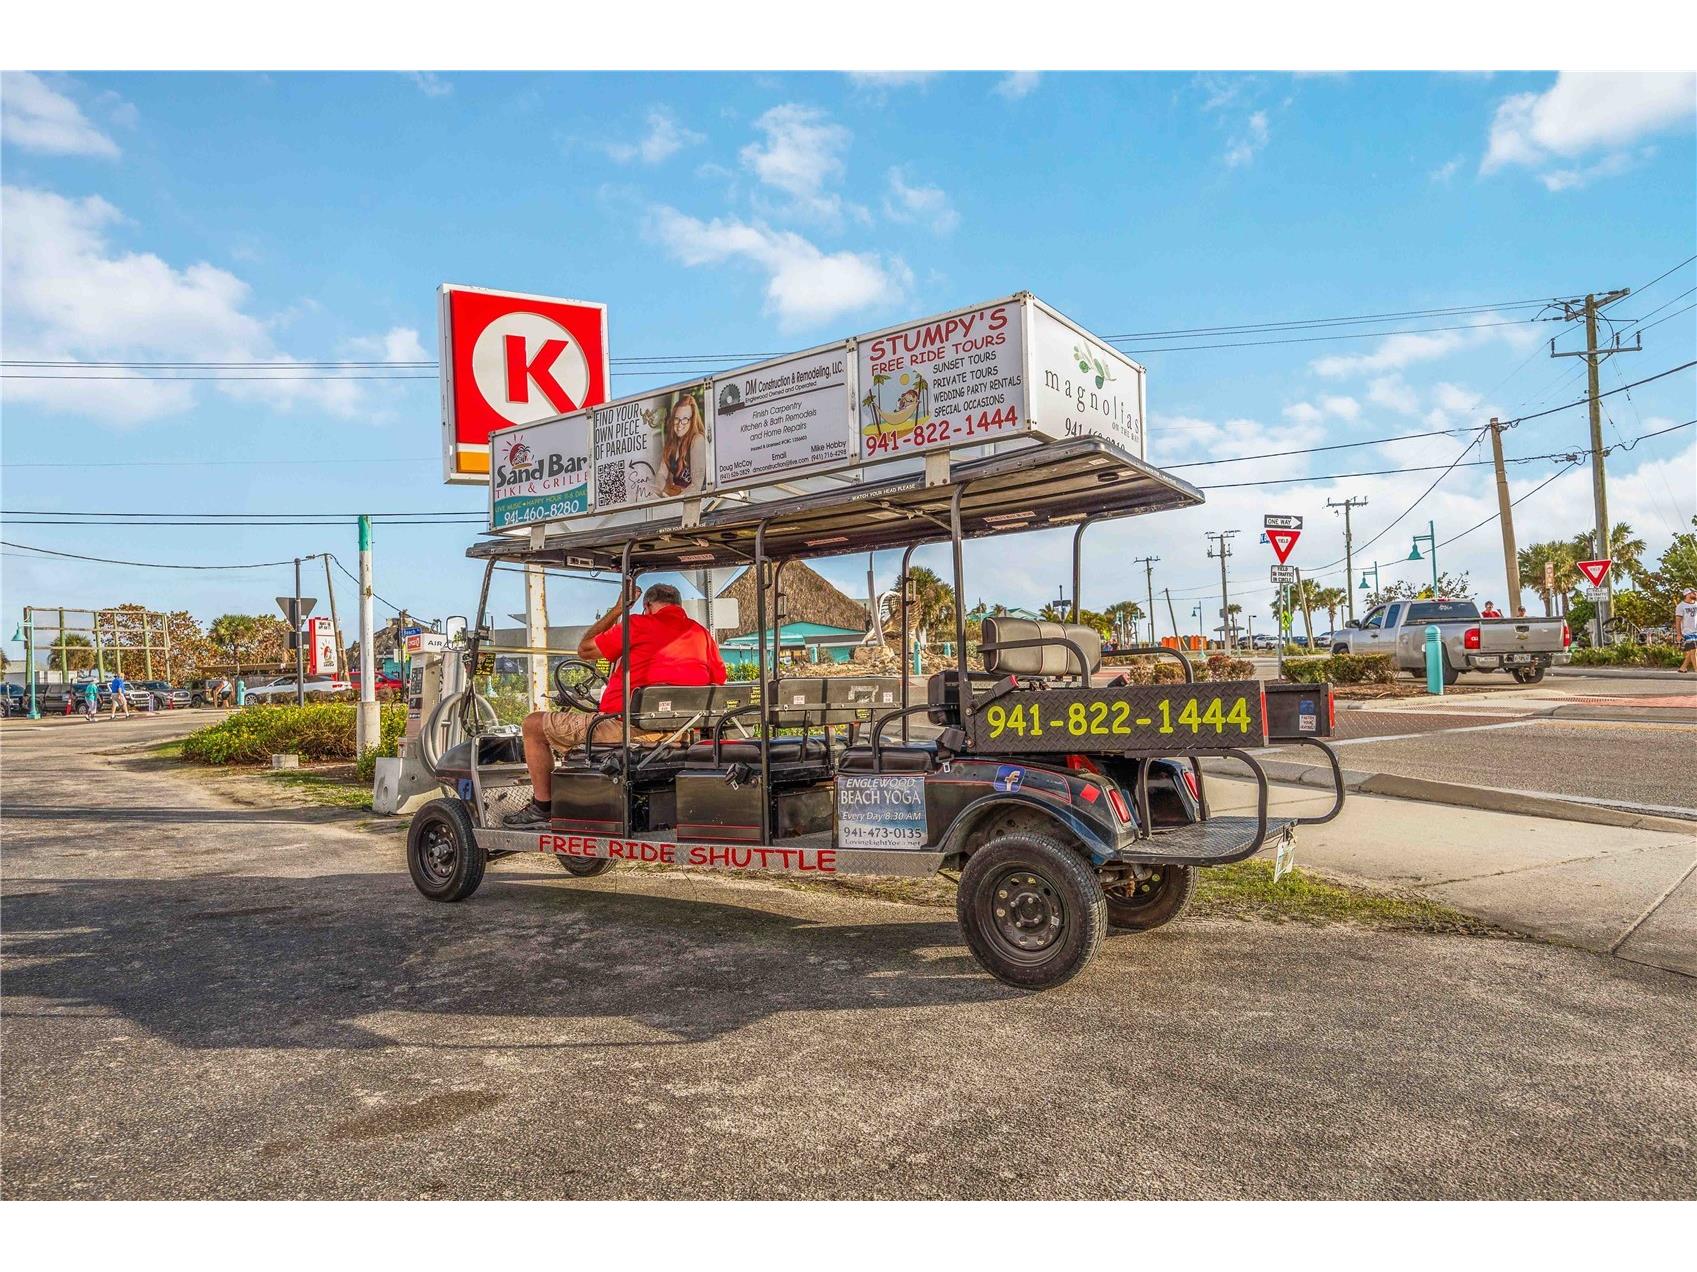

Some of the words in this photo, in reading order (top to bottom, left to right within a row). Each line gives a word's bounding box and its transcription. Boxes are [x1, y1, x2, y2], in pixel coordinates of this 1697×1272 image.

[869, 307, 1008, 361] STUMPY'S
[871, 356, 904, 376] FREE
[910, 346, 945, 366] RIDE
[952, 332, 1006, 354] TOURS
[932, 357, 965, 374] SUNSET
[968, 350, 997, 365] TOURS
[505, 334, 579, 414] K
[745, 379, 757, 396] DM
[758, 375, 791, 393] Construction
[932, 372, 966, 389] PRIVATE
[970, 365, 998, 380] TOURS
[745, 392, 768, 403] Englewood
[768, 388, 784, 398] Owned
[785, 385, 795, 394] and
[795, 381, 817, 393] Operated
[933, 388, 965, 403] WEDDING
[967, 381, 988, 395] PARTY
[989, 375, 1022, 390] RENTALS
[1045, 369, 1139, 434] magnolias
[595, 408, 613, 428] FIND
[616, 403, 640, 422] YOUR
[752, 407, 769, 419] Finish
[769, 401, 803, 416] Carpentry
[934, 403, 961, 417] SPECIAL
[963, 393, 1005, 411] OCCASIONS
[595, 425, 613, 444] OWN
[616, 418, 640, 439] PIECE
[740, 421, 763, 433] Kitchen
[763, 419, 769, 427] &
[769, 416, 784, 426] Bath
[785, 408, 817, 421] Remodels
[750, 432, 763, 441] and
[763, 428, 782, 438] Home
[783, 422, 807, 435] Repairs
[865, 405, 1018, 456] 941-822-1444
[595, 443, 604, 460] OF
[606, 433, 647, 457] PARADISE
[720, 464, 733, 472] Doug
[734, 460, 753, 469] McCoy
[811, 444, 825, 452] Mike
[825, 440, 847, 450] Hobby
[771, 451, 787, 460] Email
[496, 459, 545, 488] Sand
[548, 453, 588, 478] Bar
[495, 485, 521, 498] TIKI
[528, 481, 537, 493] &
[870, 490, 882, 498] YOUR
[504, 499, 580, 525] 941-460-8280
[987, 697, 1251, 738] 941-822-1444
[846, 778, 915, 788] ENGLEWOOD
[840, 790, 880, 804] BEACH
[884, 790, 921, 804] YOGA
[842, 811, 865, 821] Every
[866, 811, 882, 822] Day
[905, 812, 921, 820] AM
[843, 826, 922, 838] 941-473-0135
[539, 834, 597, 857] FREE
[608, 840, 676, 863] RIDE
[689, 846, 836, 872] SHUTTLE
